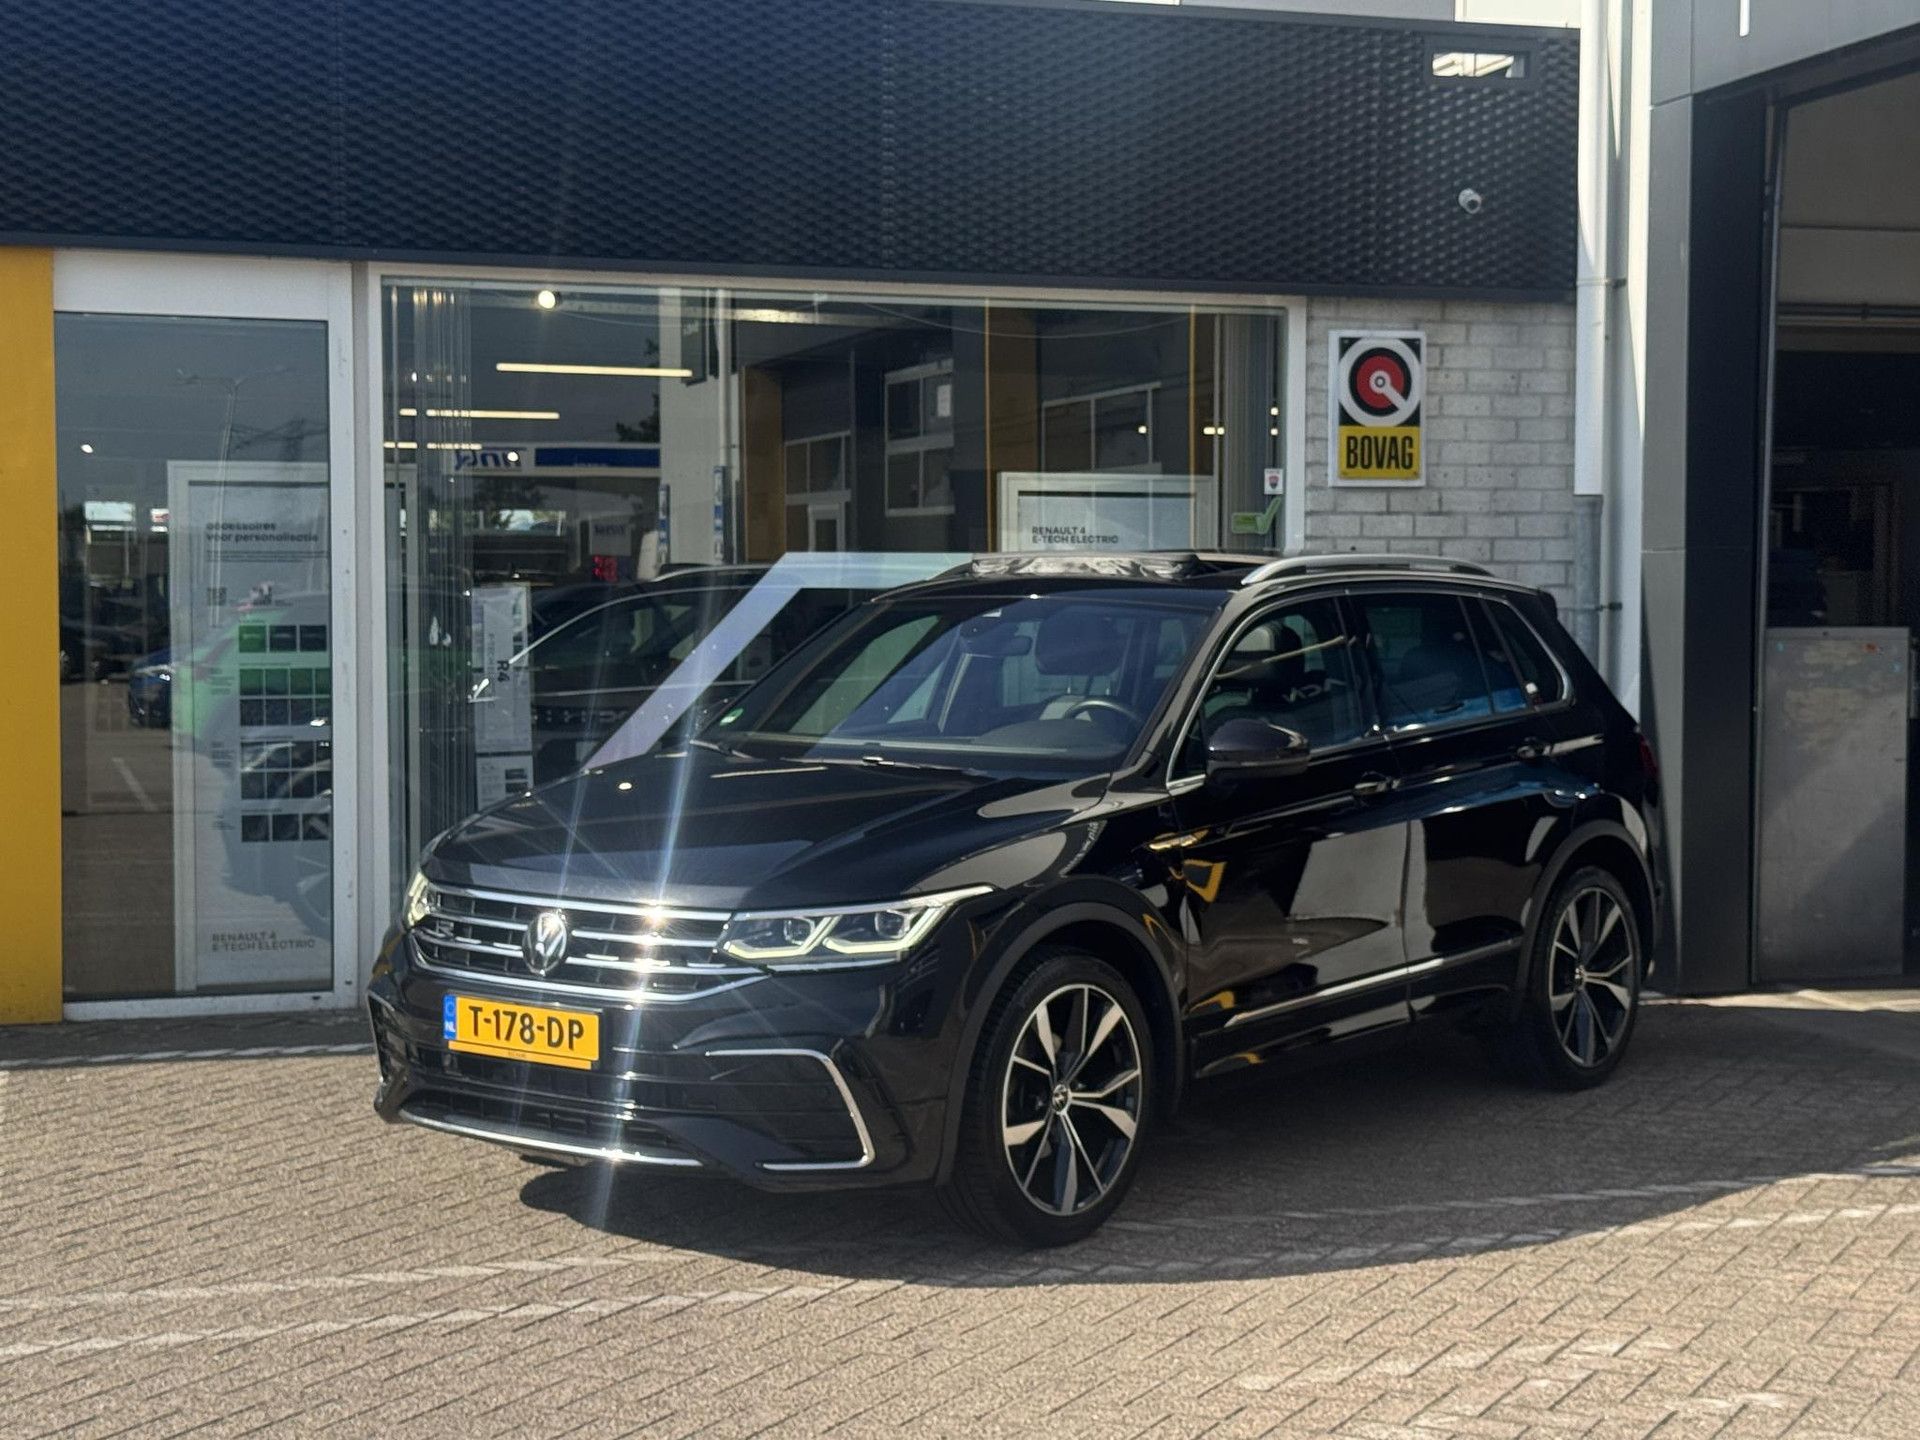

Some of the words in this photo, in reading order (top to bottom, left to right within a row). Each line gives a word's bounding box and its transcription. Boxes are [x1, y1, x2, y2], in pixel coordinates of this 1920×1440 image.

[1346, 435, 1413, 470] BOVAG
[1032, 526, 1077, 535] RENAULT
[1079, 526, 1086, 535] 4
[1032, 535, 1068, 544] E-TECH
[1070, 535, 1119, 544] ELECTRIC
[212, 931, 266, 941] RENAULT
[258, 939, 315, 950] ELECTRIC
[468, 1006, 584, 1050] T-178-DP
